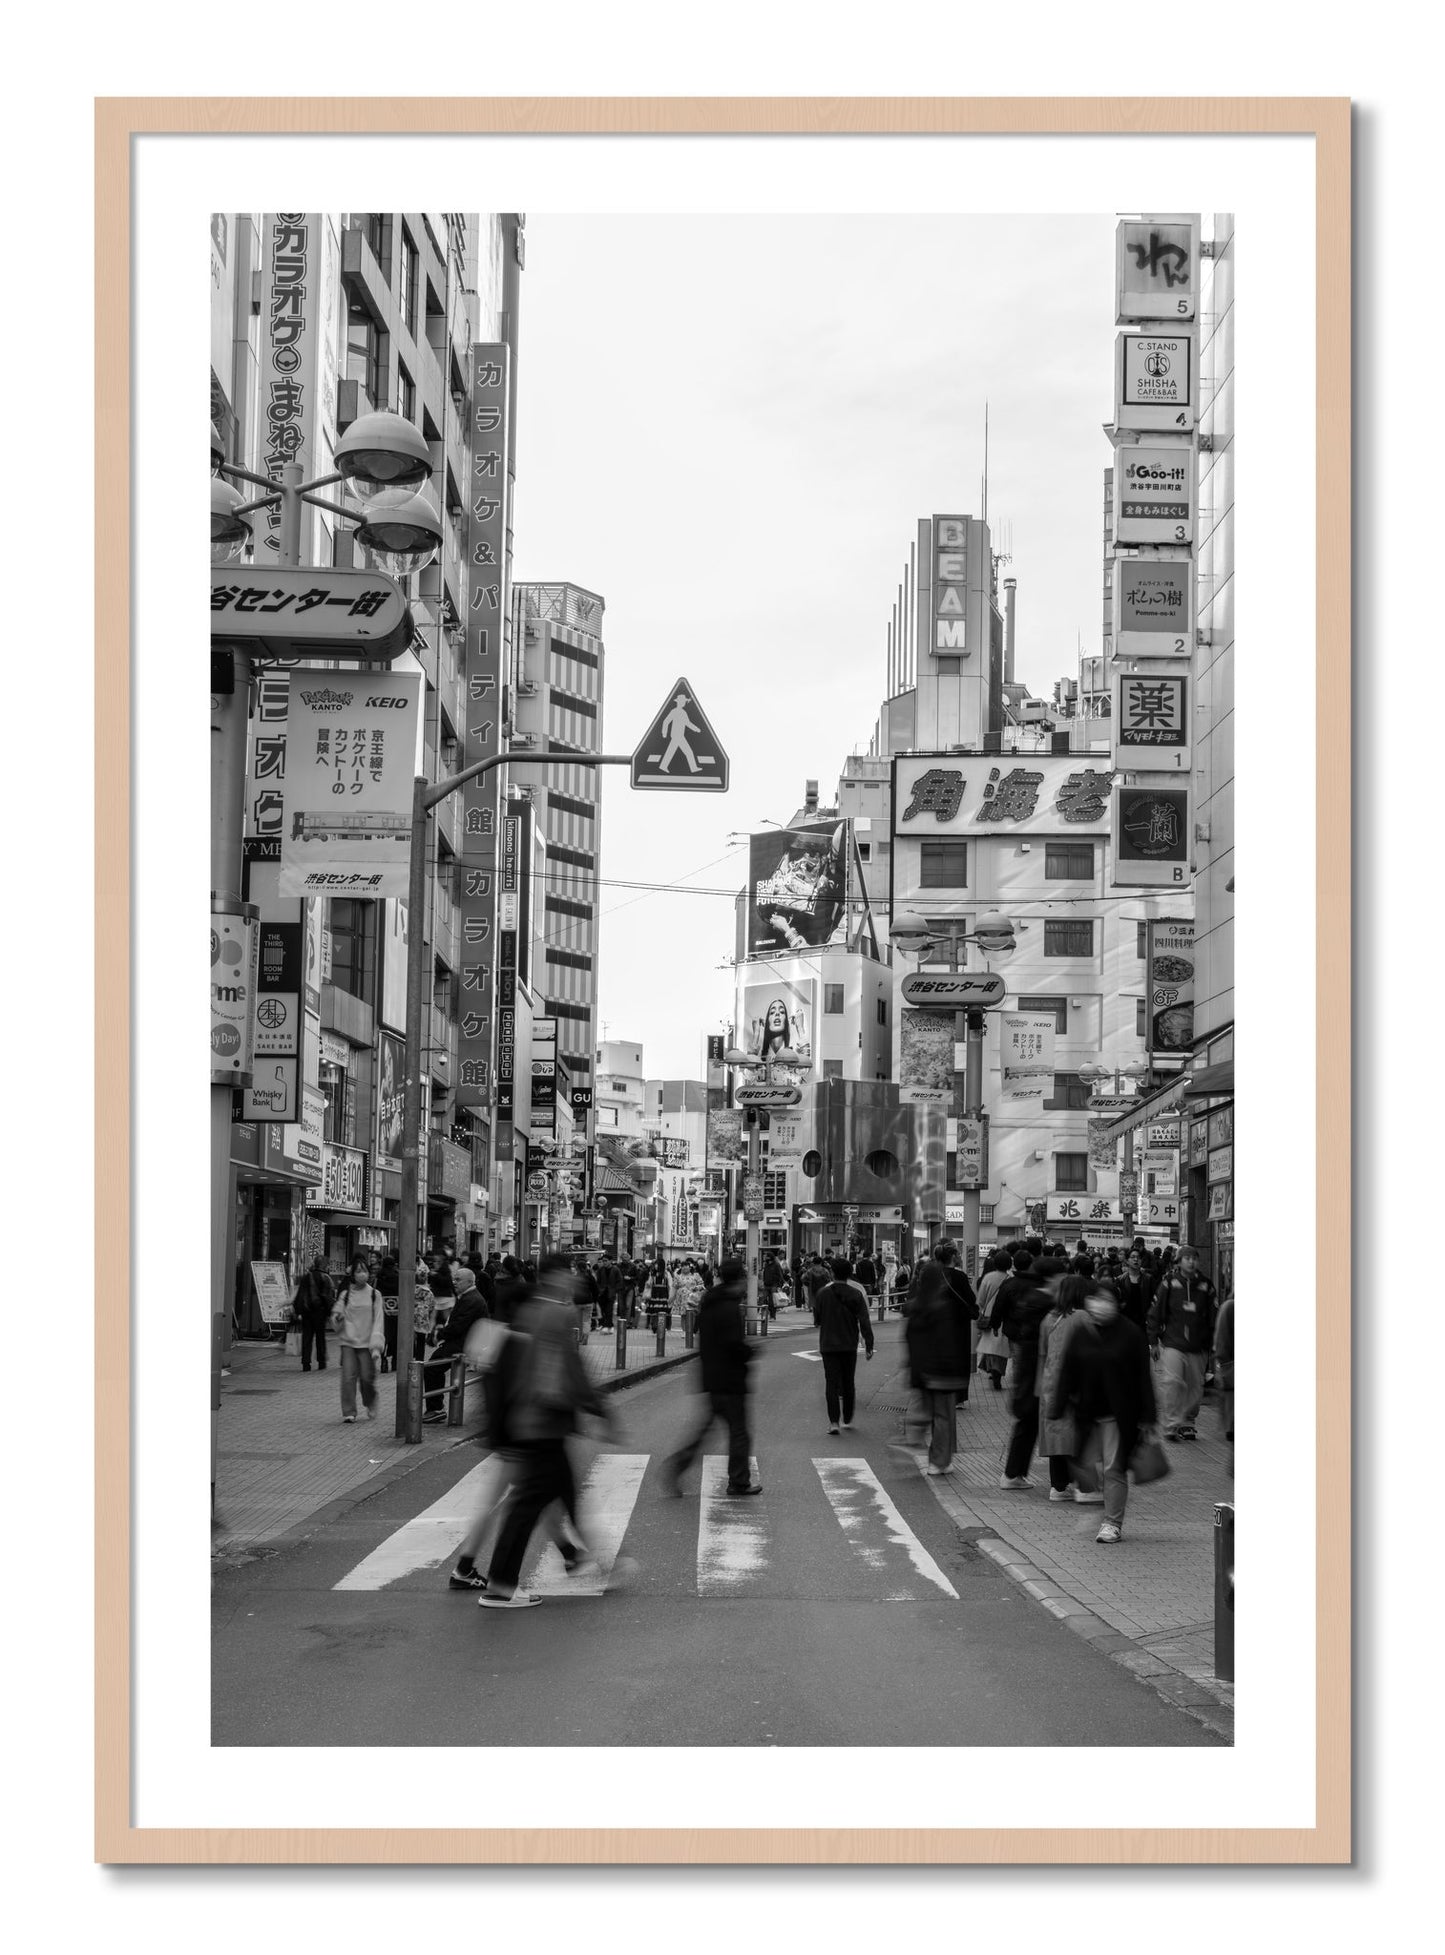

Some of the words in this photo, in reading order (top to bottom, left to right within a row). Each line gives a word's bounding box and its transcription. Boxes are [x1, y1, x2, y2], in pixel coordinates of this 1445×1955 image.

[270, 224, 307, 346] カラオケ
[1177, 300, 1188, 313] 5
[1137, 342, 1178, 351] C.STAND
[1137, 378, 1177, 388] SHISHA
[1137, 388, 1177, 396] CAFE&BAR
[1176, 412, 1187, 426] 4
[1136, 465, 1185, 479] Goo-it!
[1125, 505, 1186, 516] 全身もみほぐし
[1175, 525, 1186, 540] 3
[937, 519, 966, 648] BEAM
[1127, 590, 1184, 607] ポムの樹
[1174, 638, 1185, 653] 2
[311, 703, 343, 711] KANTO
[365, 696, 409, 709] KEIO
[1129, 681, 1174, 728] 薬
[1123, 730, 1180, 743] マツモトキヨシ
[315, 728, 330, 767] 冒険へ
[331, 728, 348, 795] カントーの
[369, 729, 385, 783] 京王線で
[1174, 753, 1181, 767] 1
[902, 767, 1115, 822] 角海老
[1124, 802, 1179, 846] 一蘭
[505, 821, 514, 853] kimono
[304, 873, 384, 885] 渋谷センター街
[505, 857, 514, 888] hearts
[1173, 867, 1184, 881] B
[263, 940, 284, 948] THIRD
[263, 965, 283, 973] ROOM
[460, 868, 491, 1090] カラオケ館
[908, 981, 999, 993] 渋谷センター街
[1153, 989, 1179, 1007] 6F
[221, 1032, 239, 1044] Day!
[253, 1089, 283, 1100] Whisky
[573, 1092, 591, 1103] GU
[738, 1090, 793, 1098] 渋谷センター街
[253, 1098, 270, 1106] Bank
[678, 1197, 687, 1236] BEER
